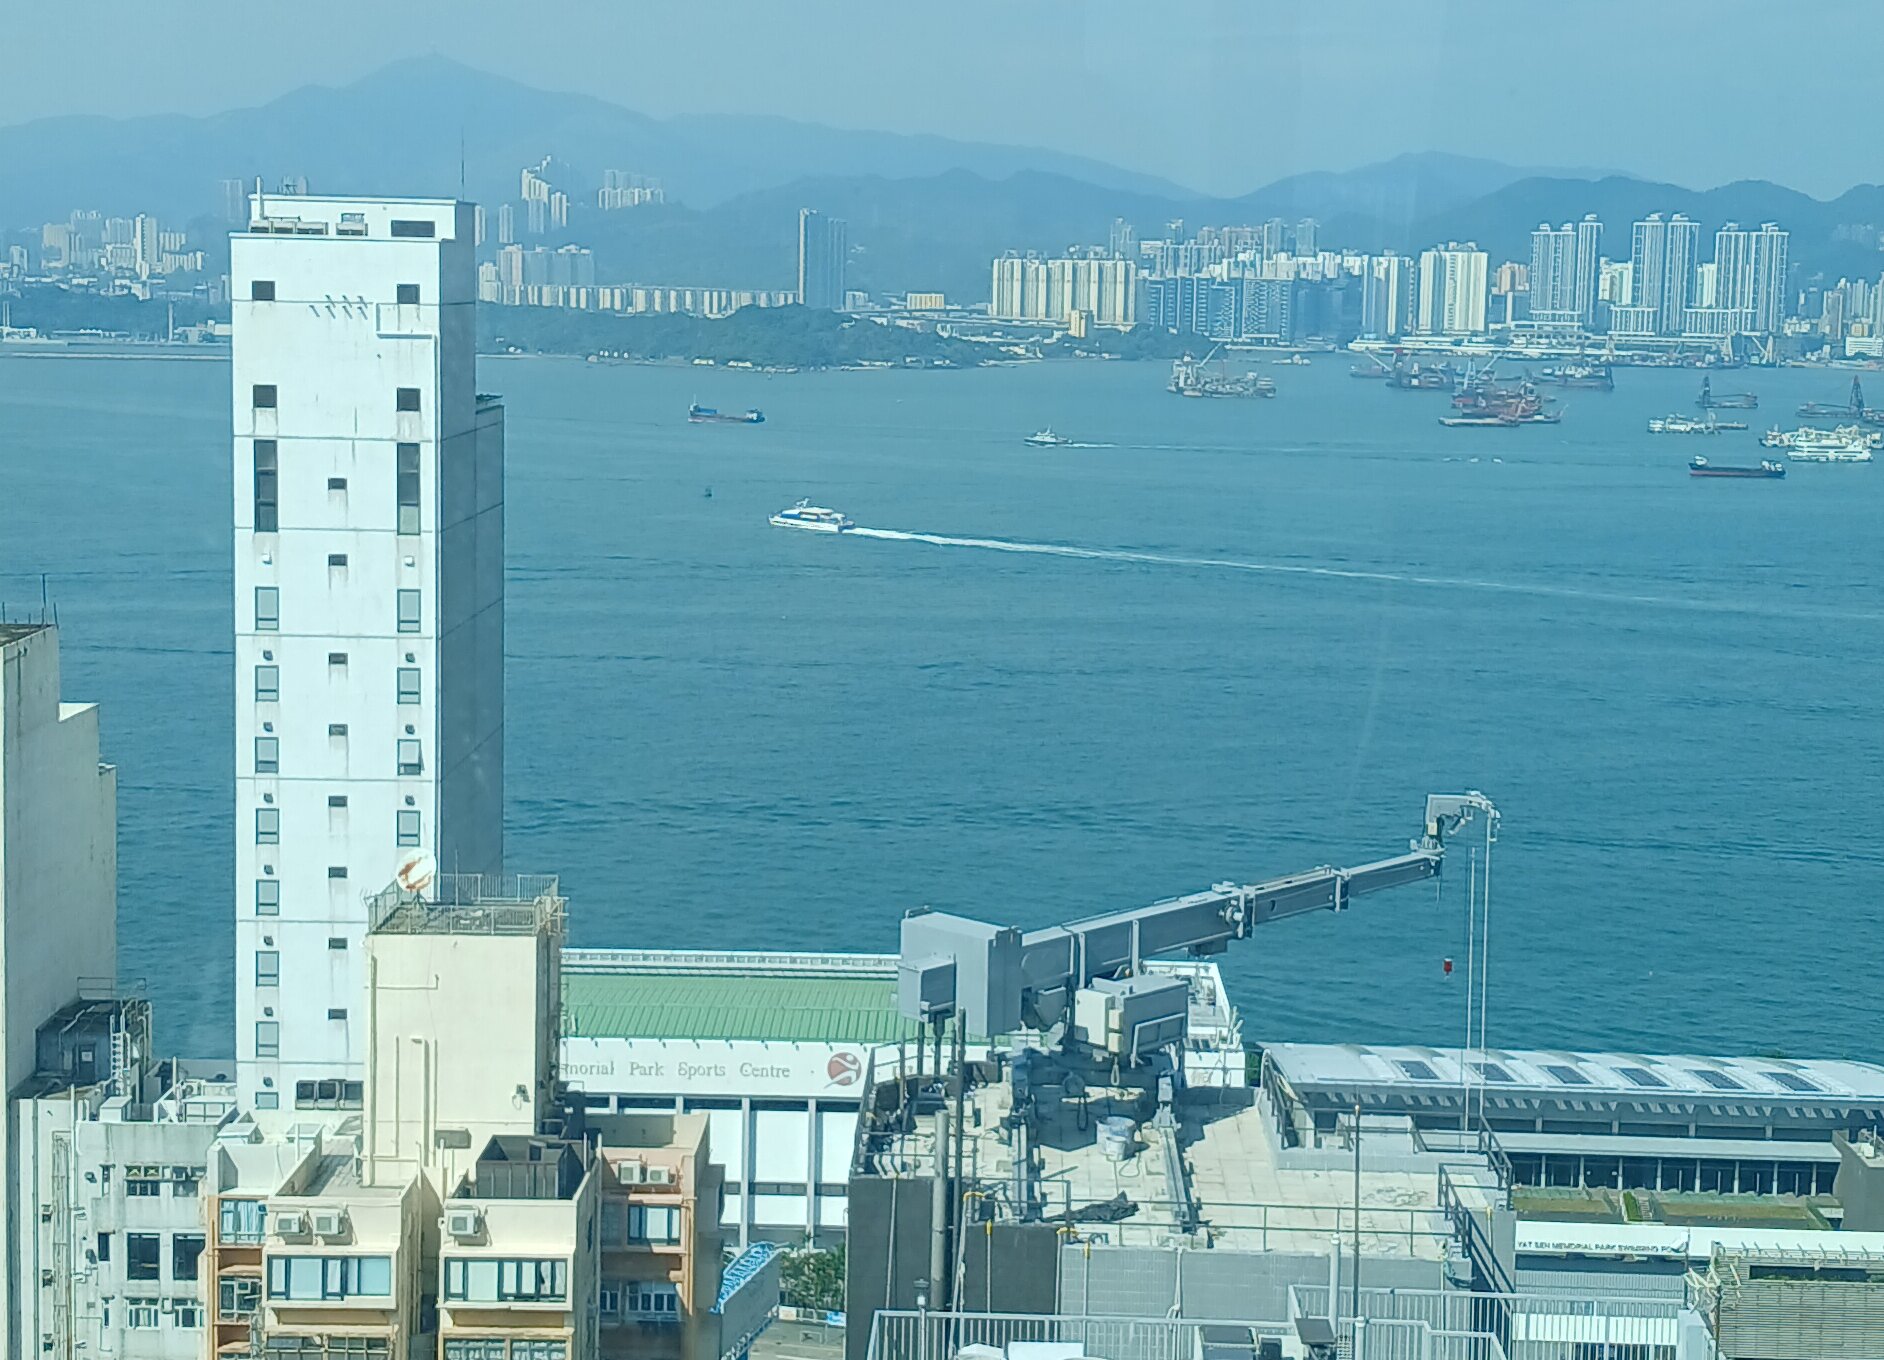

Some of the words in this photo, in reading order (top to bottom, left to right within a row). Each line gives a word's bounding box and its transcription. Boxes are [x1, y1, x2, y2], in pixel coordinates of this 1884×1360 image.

[630, 1061, 664, 1077] Park
[678, 1061, 726, 1080] Sports
[740, 1062, 791, 1078] Centre
